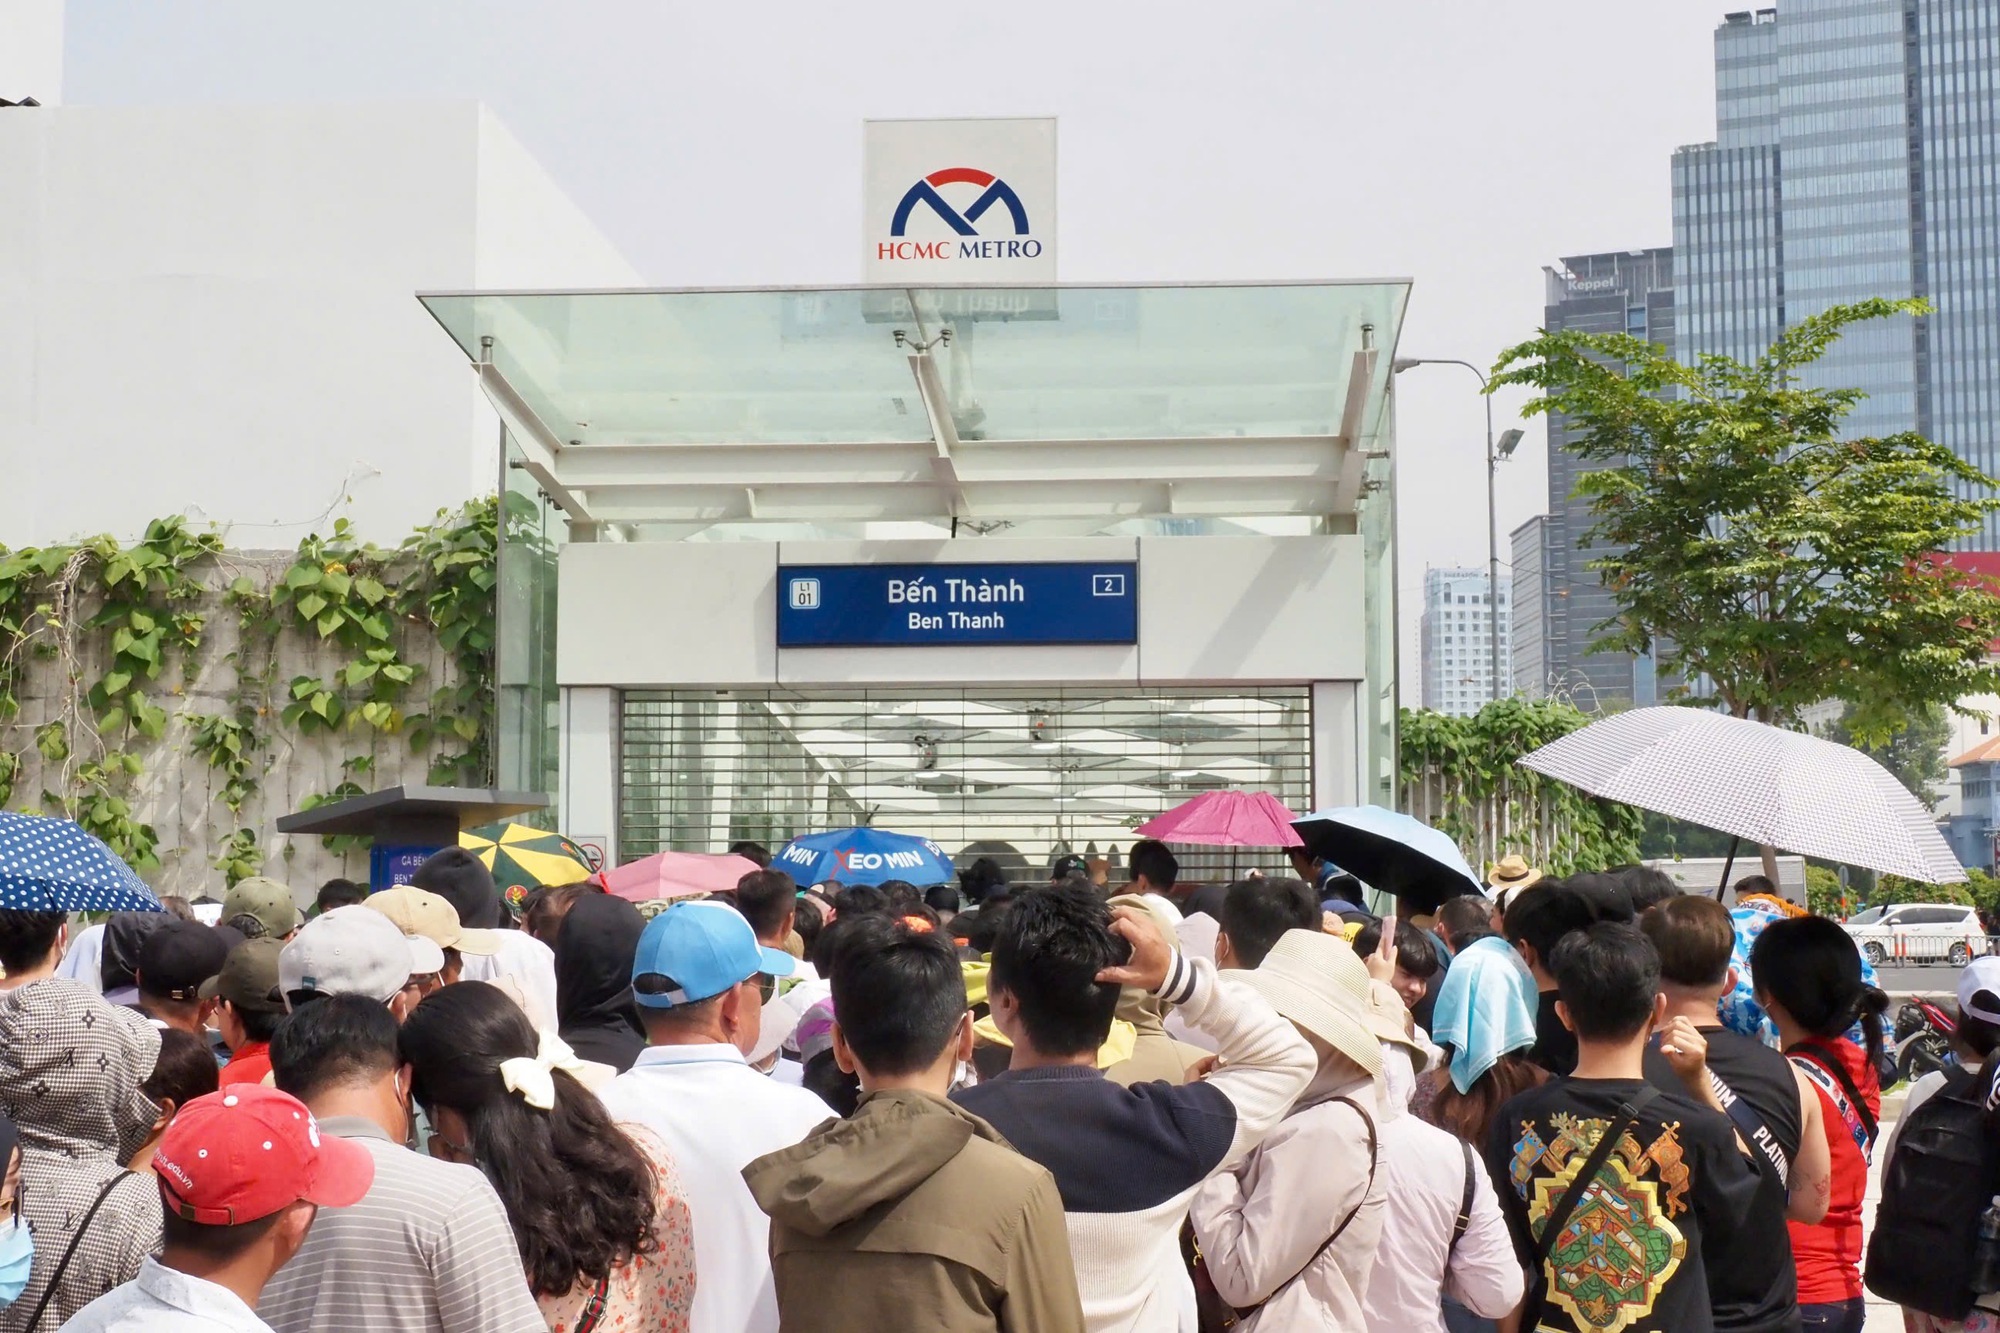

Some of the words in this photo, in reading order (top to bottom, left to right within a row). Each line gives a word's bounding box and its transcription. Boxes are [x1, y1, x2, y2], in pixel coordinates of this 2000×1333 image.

[878, 241, 950, 260] HCMC
[959, 239, 1042, 258] METRO
[1568, 276, 1614, 291] Keppel
[800, 582, 810, 592] L1
[888, 576, 937, 603] Bến
[944, 578, 1024, 602] Thành
[1104, 578, 1113, 592] 2
[798, 592, 812, 606] 01
[908, 612, 942, 629] Ben
[948, 611, 1004, 629] Thanh
[401, 855, 412, 866] GA
[782, 844, 820, 866] MIN
[394, 873, 408, 884] BEN
[1752, 1125, 1789, 1191] PLATINU
